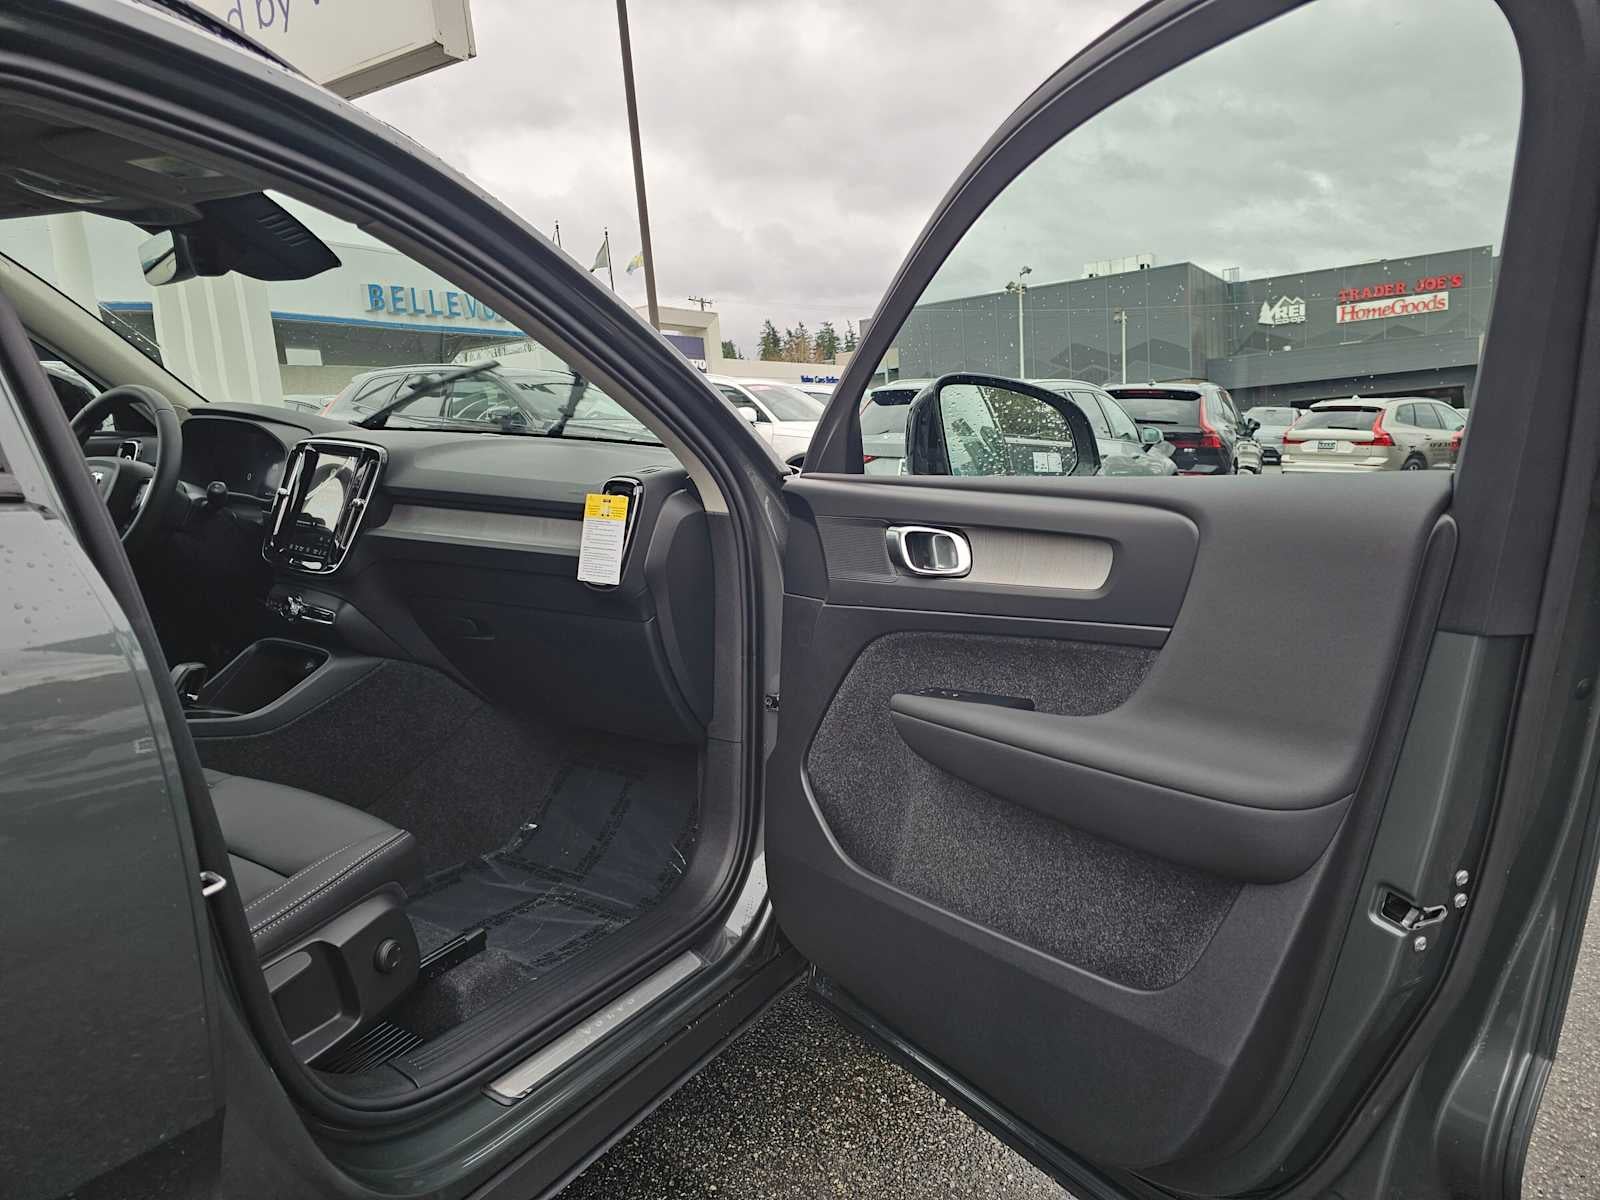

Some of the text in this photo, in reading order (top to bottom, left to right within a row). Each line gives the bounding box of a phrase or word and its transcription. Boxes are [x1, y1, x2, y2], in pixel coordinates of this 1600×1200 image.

[1338, 274, 1464, 302] TRADER JOE'S
[1275, 303, 1305, 319] REI
[1340, 294, 1446, 322] HomeGoods
